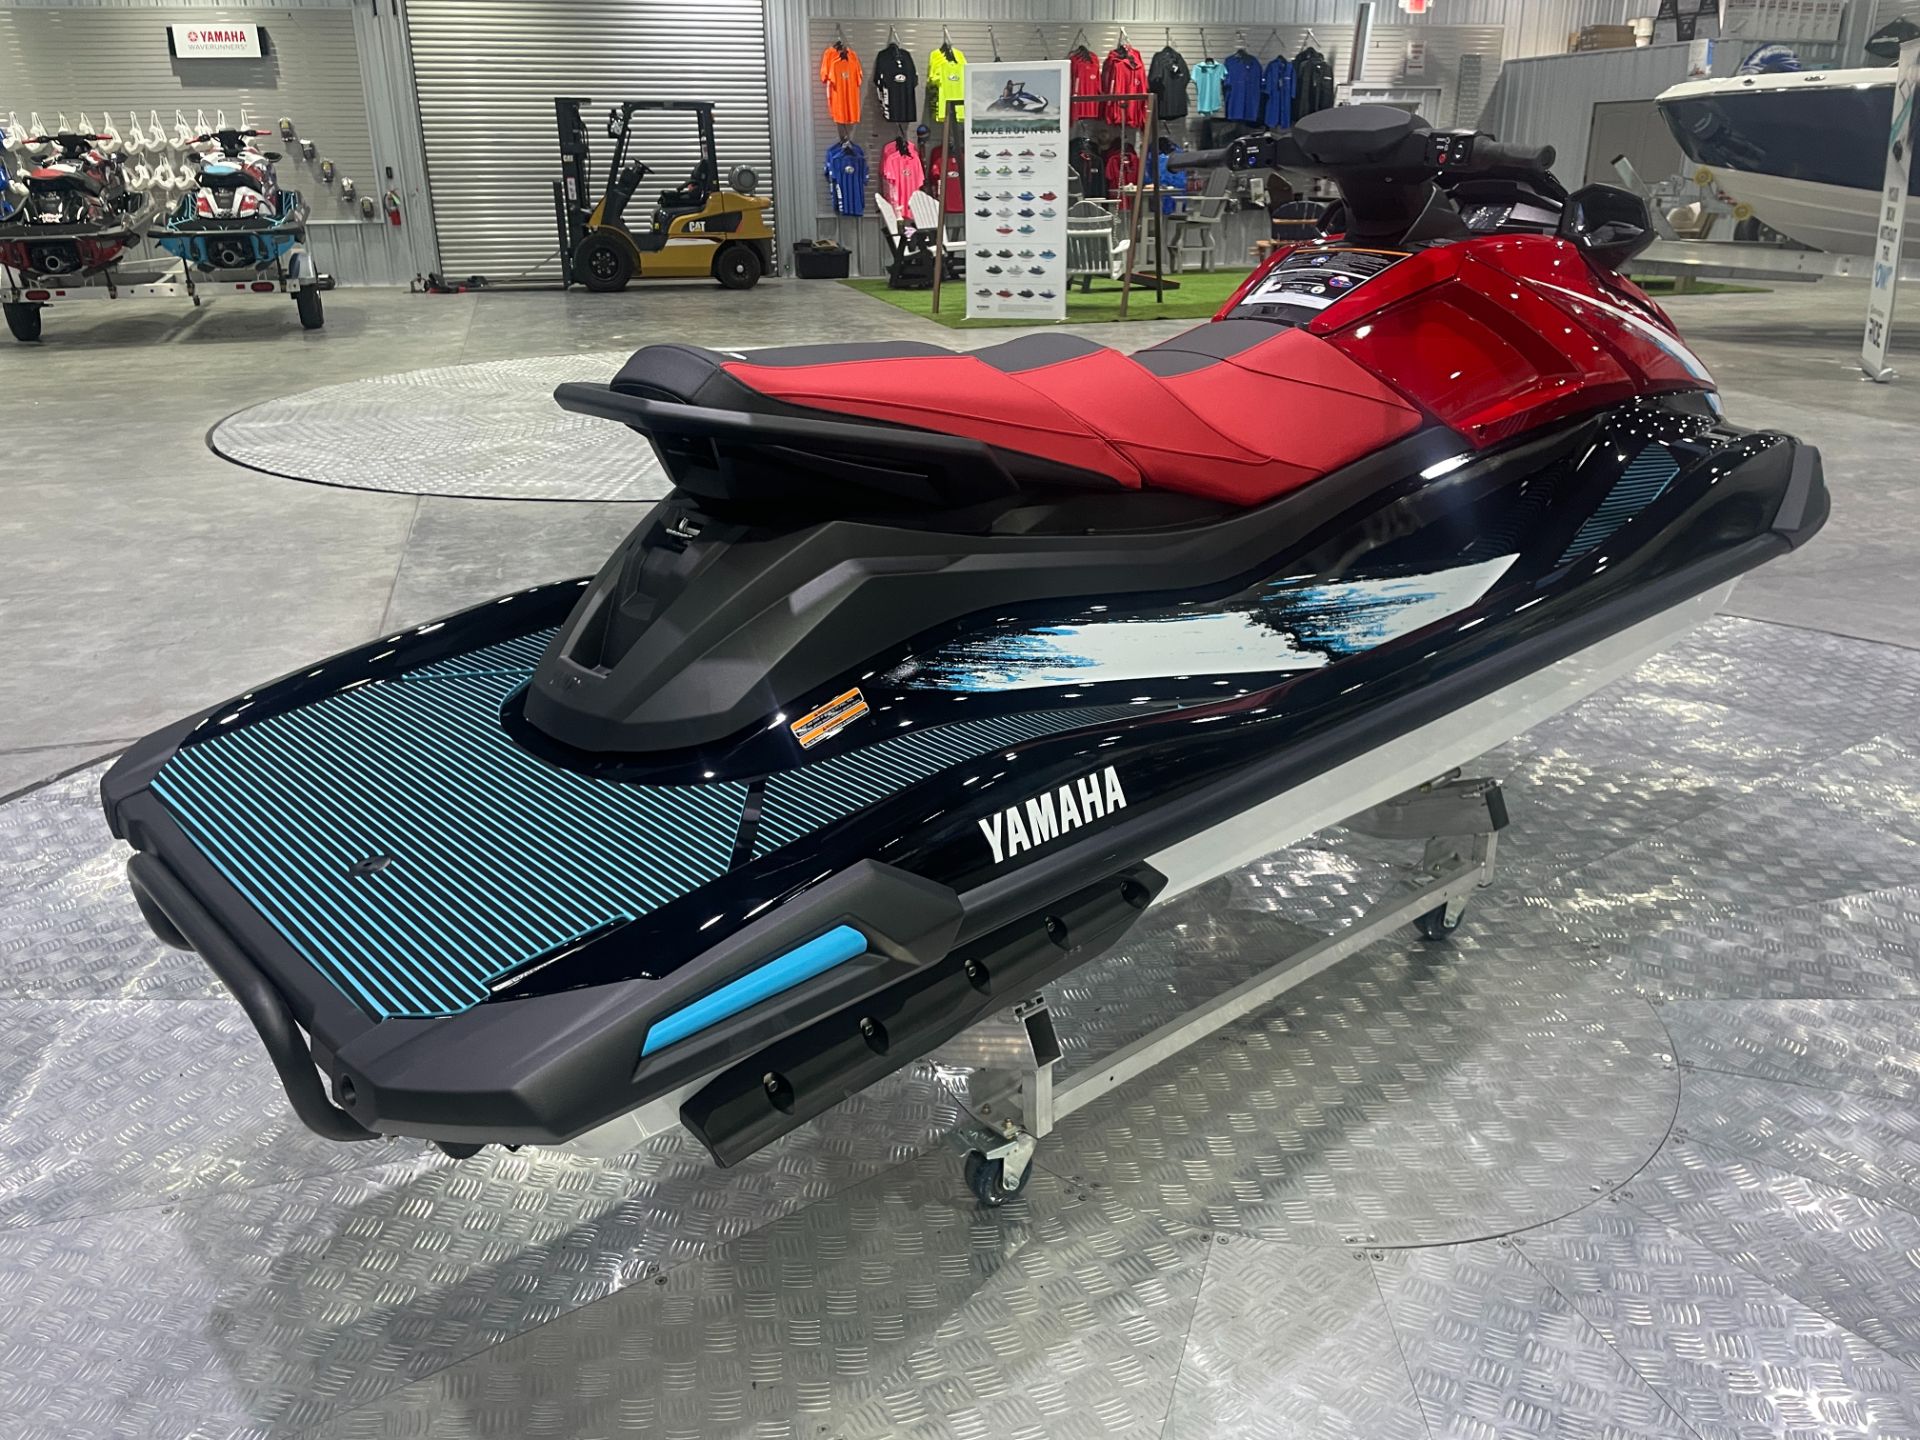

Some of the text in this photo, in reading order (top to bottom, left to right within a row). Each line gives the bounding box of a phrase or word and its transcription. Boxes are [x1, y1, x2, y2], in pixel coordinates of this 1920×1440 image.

[200, 31, 246, 42] YAMAHA
[971, 126, 1061, 135] WAVERUNNERS
[689, 221, 706, 233] CAT
[978, 765, 1128, 864] YAMAHA
